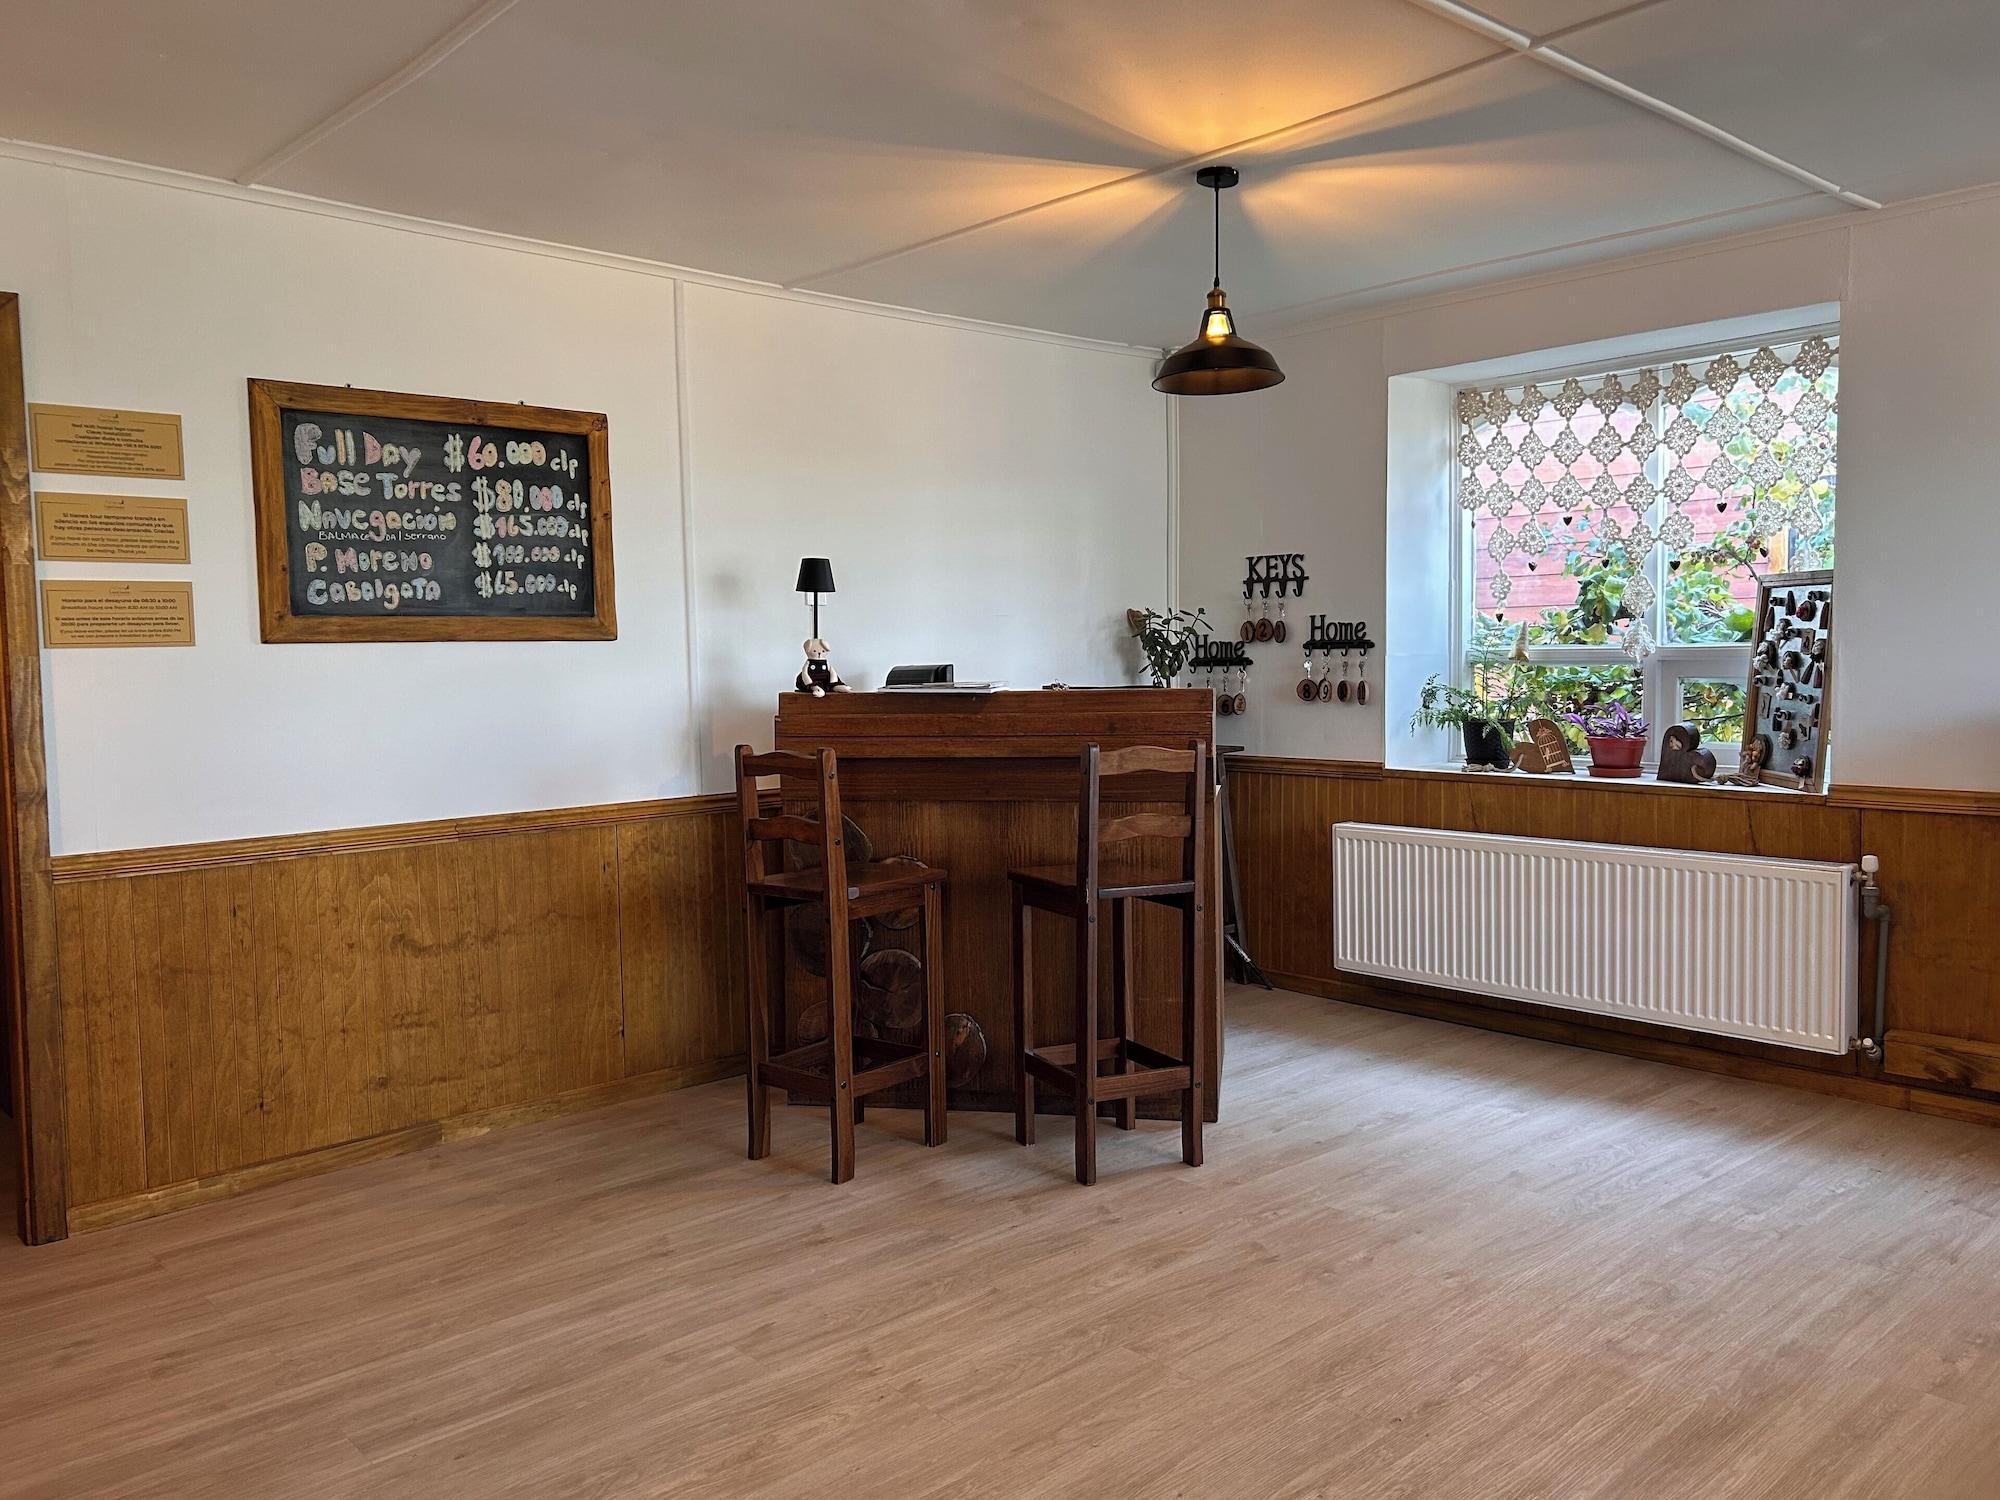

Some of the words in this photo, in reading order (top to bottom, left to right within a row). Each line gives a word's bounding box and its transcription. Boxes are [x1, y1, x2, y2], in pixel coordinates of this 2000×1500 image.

[294, 423, 355, 466] Full
[363, 431, 421, 478] Day
[550, 449, 579, 479] clp
[376, 472, 462, 501] Torres
[566, 493, 587, 519] clp
[569, 523, 588, 547] clp
[305, 542, 328, 572] P.
[563, 546, 585, 570] clp
[1245, 554, 1305, 581] KEYS
[557, 579, 578, 600] clp
[1309, 614, 1367, 642] Home
[1195, 634, 1246, 660] Home
[1302, 684, 1311, 699] 8
[1322, 684, 1330, 700] 9
